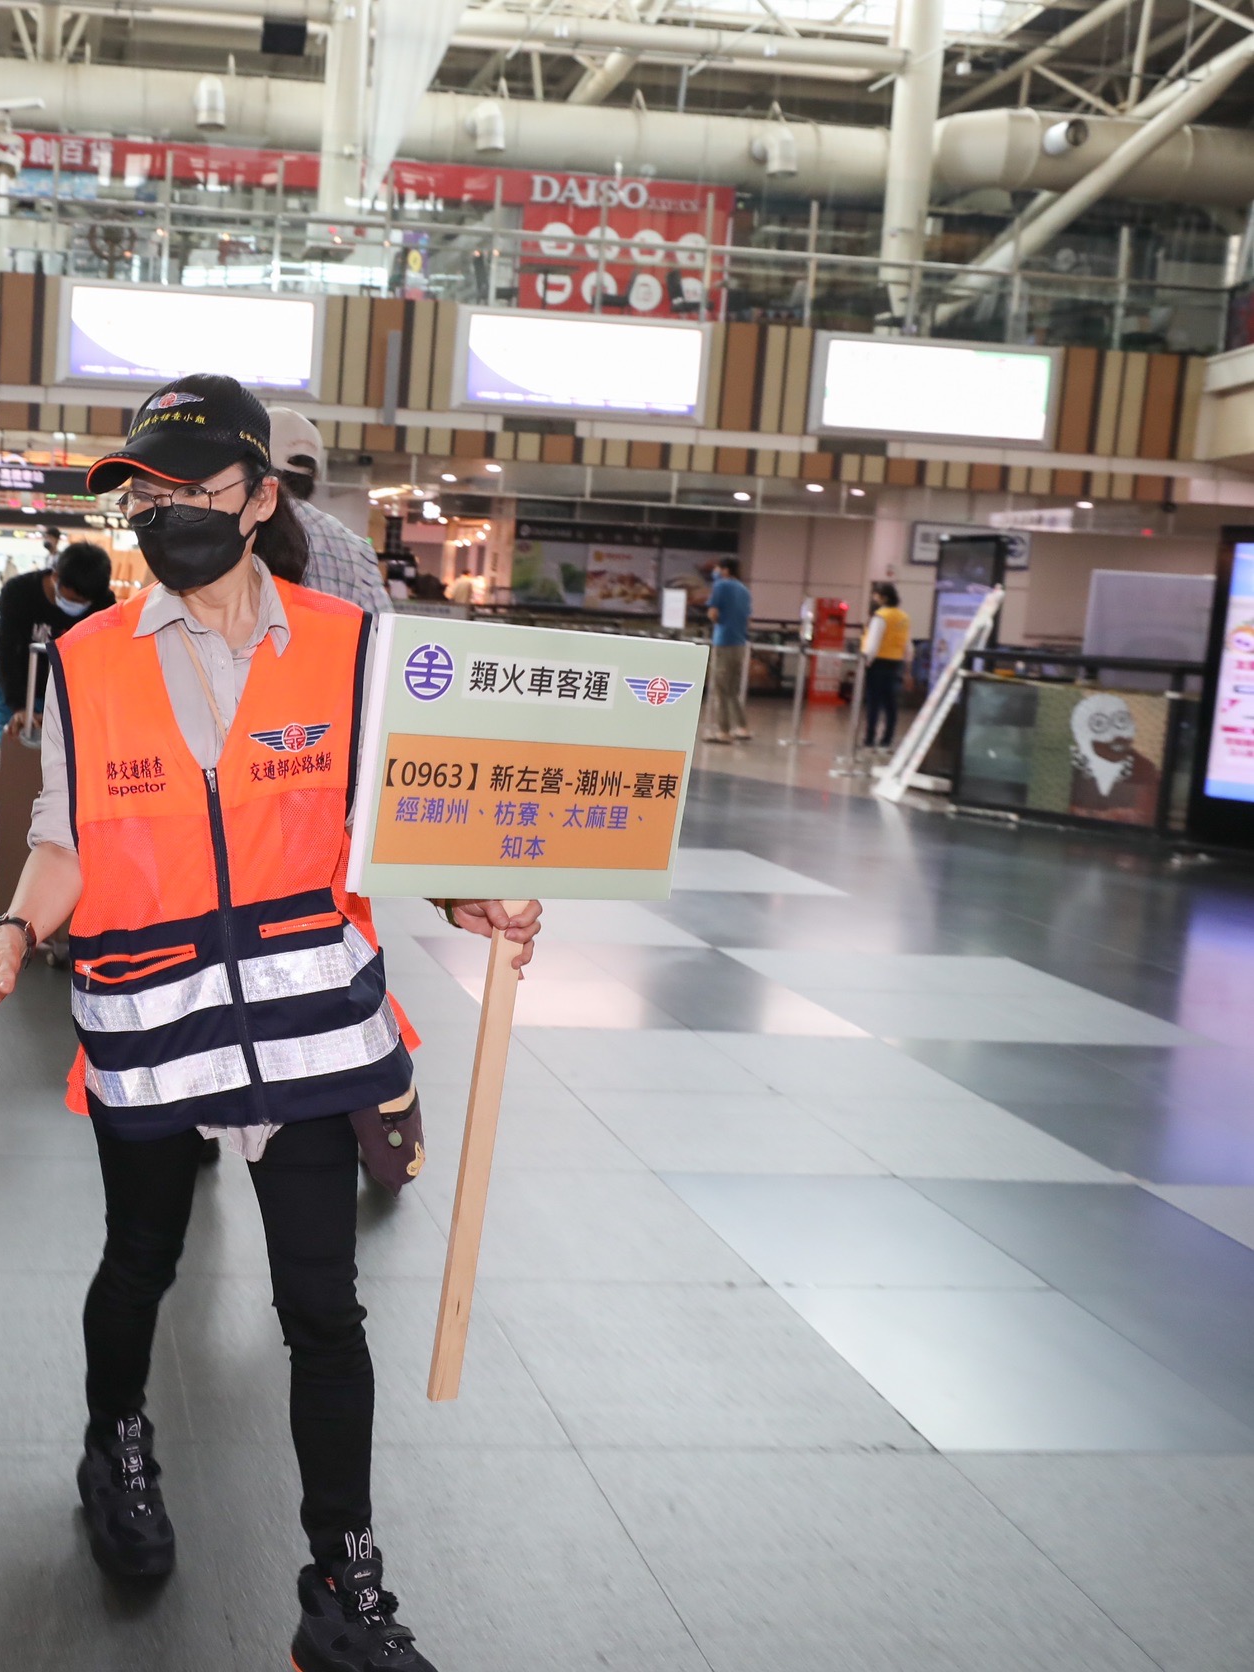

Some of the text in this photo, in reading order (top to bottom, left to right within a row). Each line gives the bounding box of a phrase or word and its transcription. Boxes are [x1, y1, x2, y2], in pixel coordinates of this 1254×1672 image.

[531, 175, 648, 208] DAISO
[468, 660, 611, 702] 類火車客運
[499, 834, 546, 861] 知本
